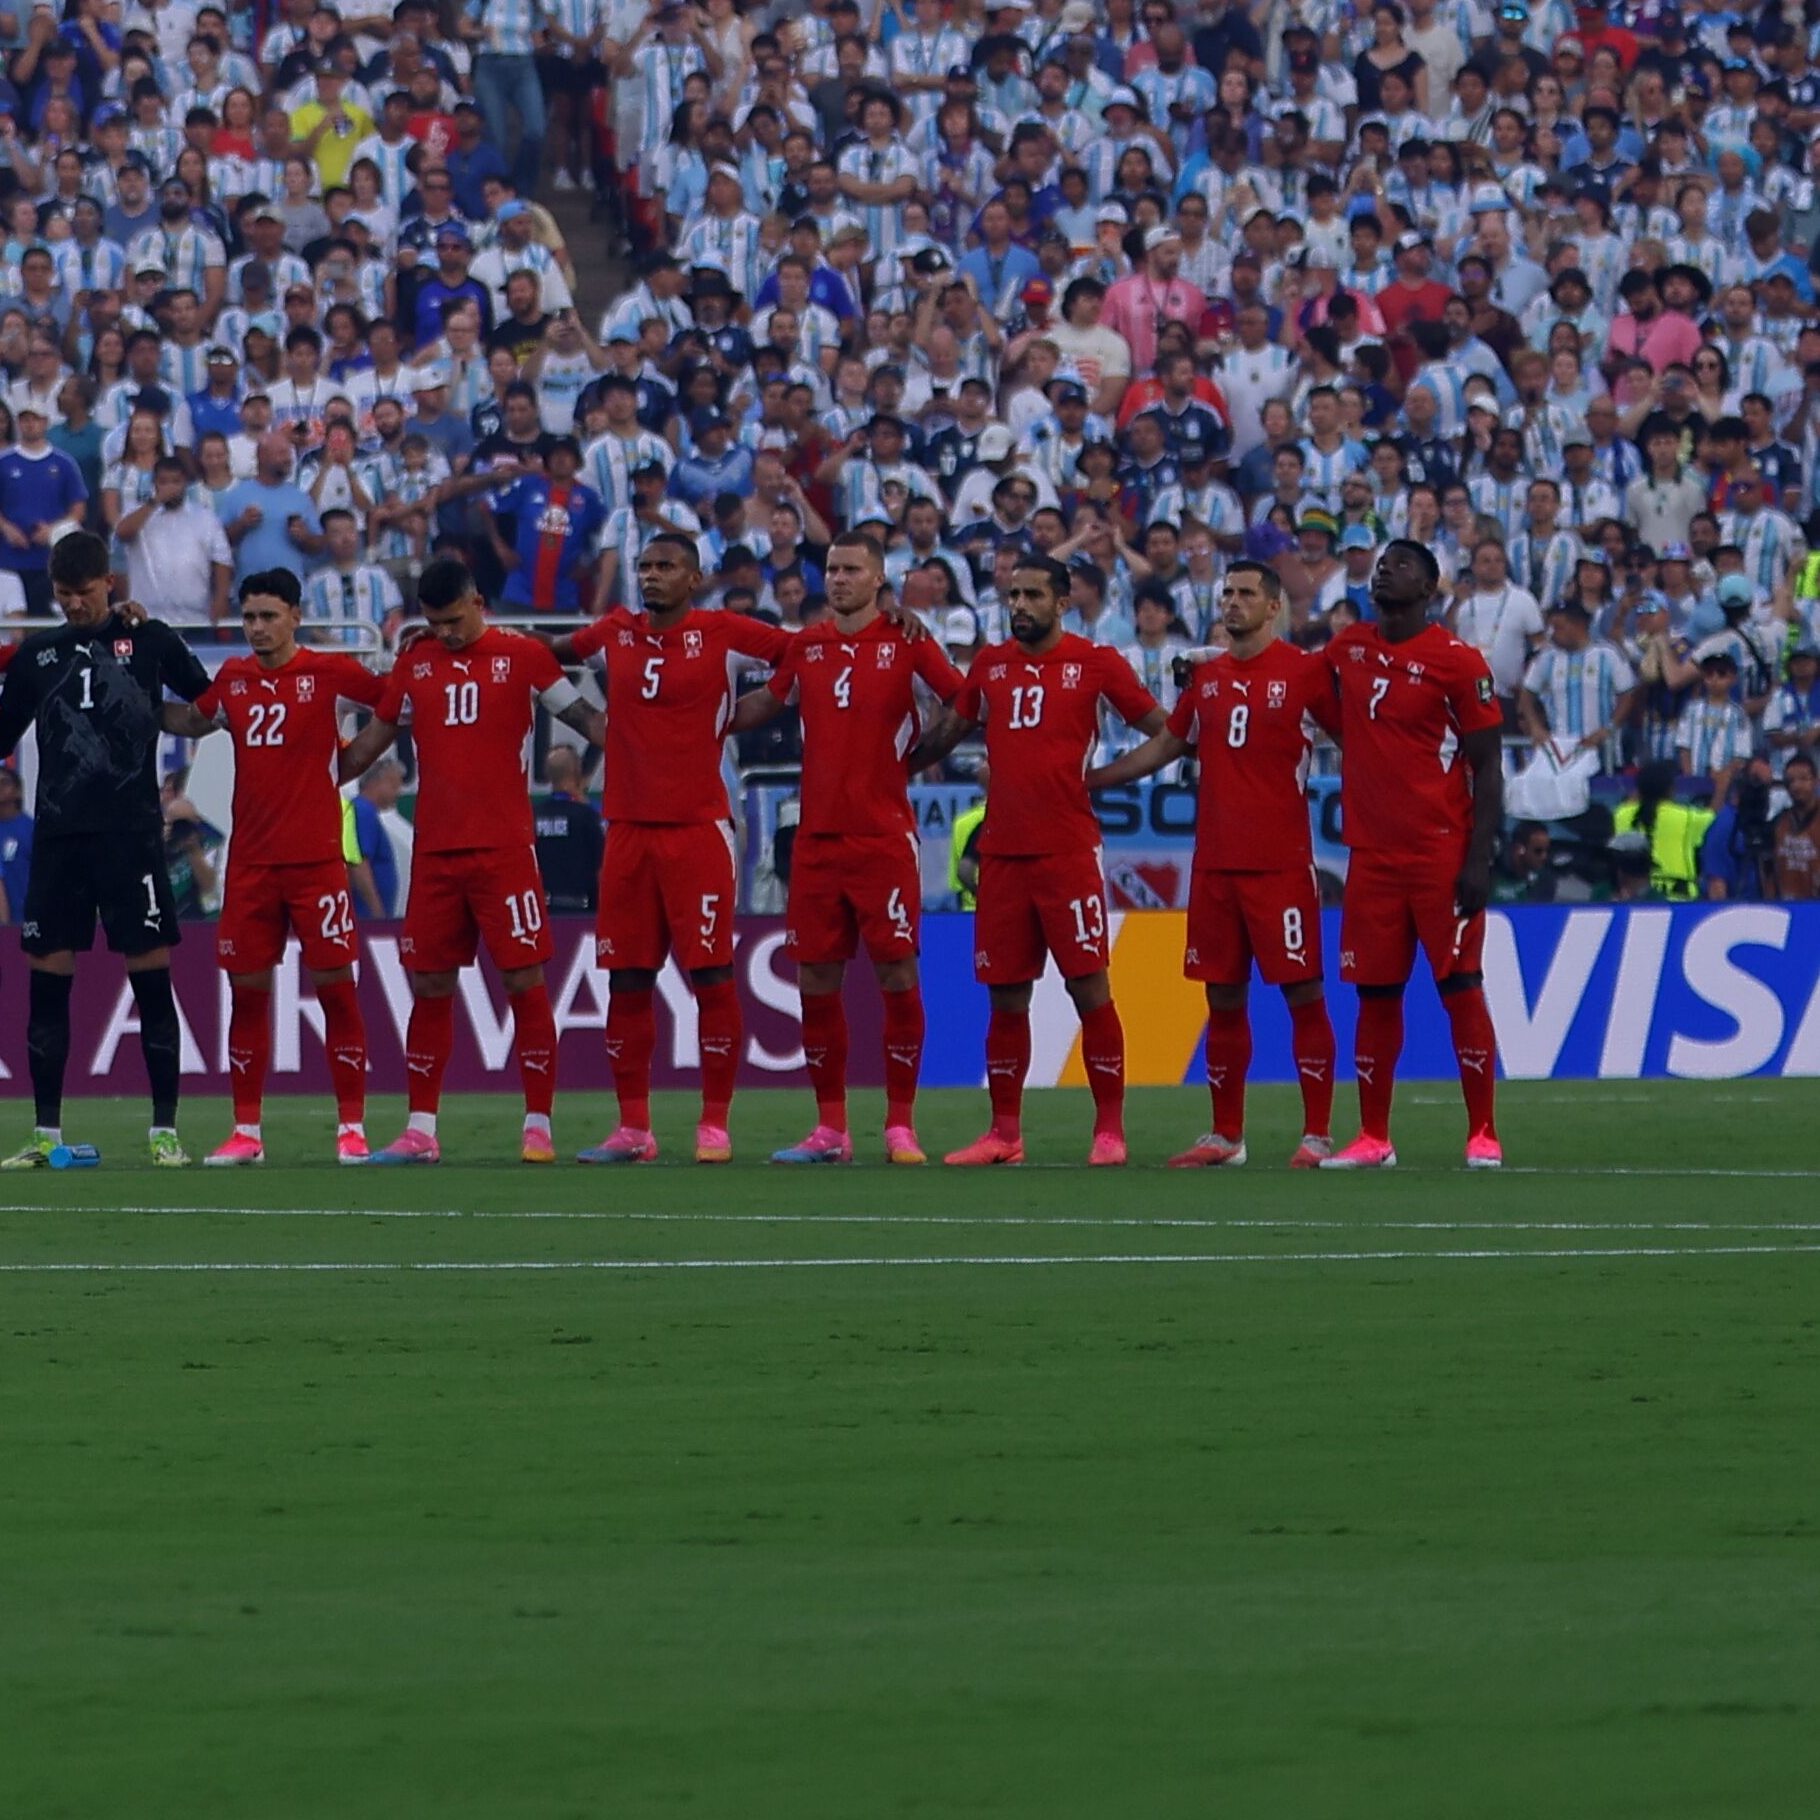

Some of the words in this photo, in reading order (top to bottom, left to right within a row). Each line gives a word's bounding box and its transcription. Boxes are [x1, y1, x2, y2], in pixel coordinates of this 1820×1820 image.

[78, 666, 95, 710] 1
[640, 657, 664, 700] 5
[833, 665, 853, 709] 4
[1368, 676, 1391, 721] 7
[245, 702, 287, 747] 22
[443, 680, 480, 727] 10
[1008, 684, 1045, 730] 13
[1227, 704, 1250, 749] 8
[141, 873, 162, 918] 1
[317, 889, 355, 939] 22
[504, 888, 543, 938] 10
[699, 893, 720, 937] 5
[886, 887, 910, 932] 4
[1068, 893, 1105, 944] 13
[1282, 906, 1304, 953] 8
[1480, 905, 1820, 1079] VIS
